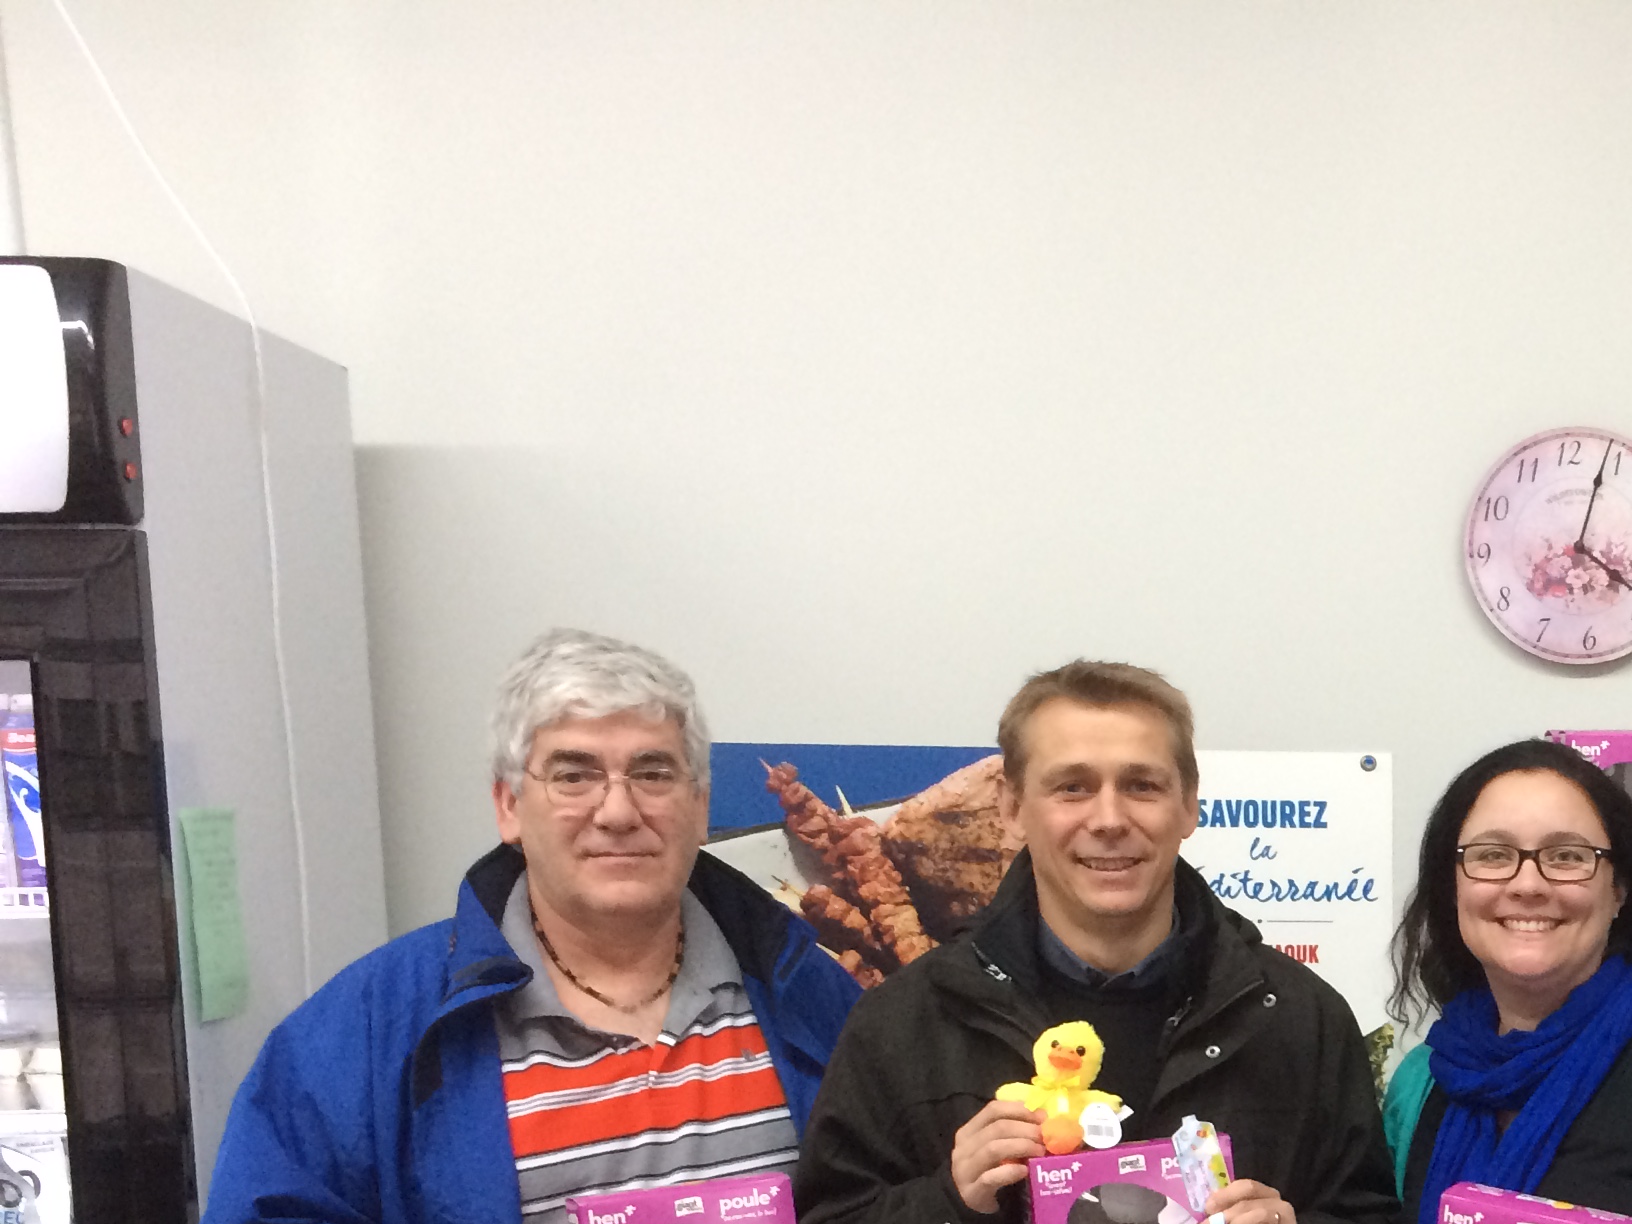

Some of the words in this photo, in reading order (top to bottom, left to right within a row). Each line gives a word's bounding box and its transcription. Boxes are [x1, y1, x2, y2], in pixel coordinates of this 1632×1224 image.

[1558, 440, 1581, 467] 12
[1613, 451, 1622, 476] 1
[1517, 457, 1539, 484] 11
[1483, 495, 1510, 522] 10
[1476, 542, 1492, 566] 9
[1496, 586, 1511, 612] 8
[1535, 617, 1551, 643] 7
[1582, 626, 1597, 651] 6
[1195, 798, 1328, 829] SAVOUREZ
[1249, 837, 1278, 860] la
[1197, 866, 1379, 902] diterranée
